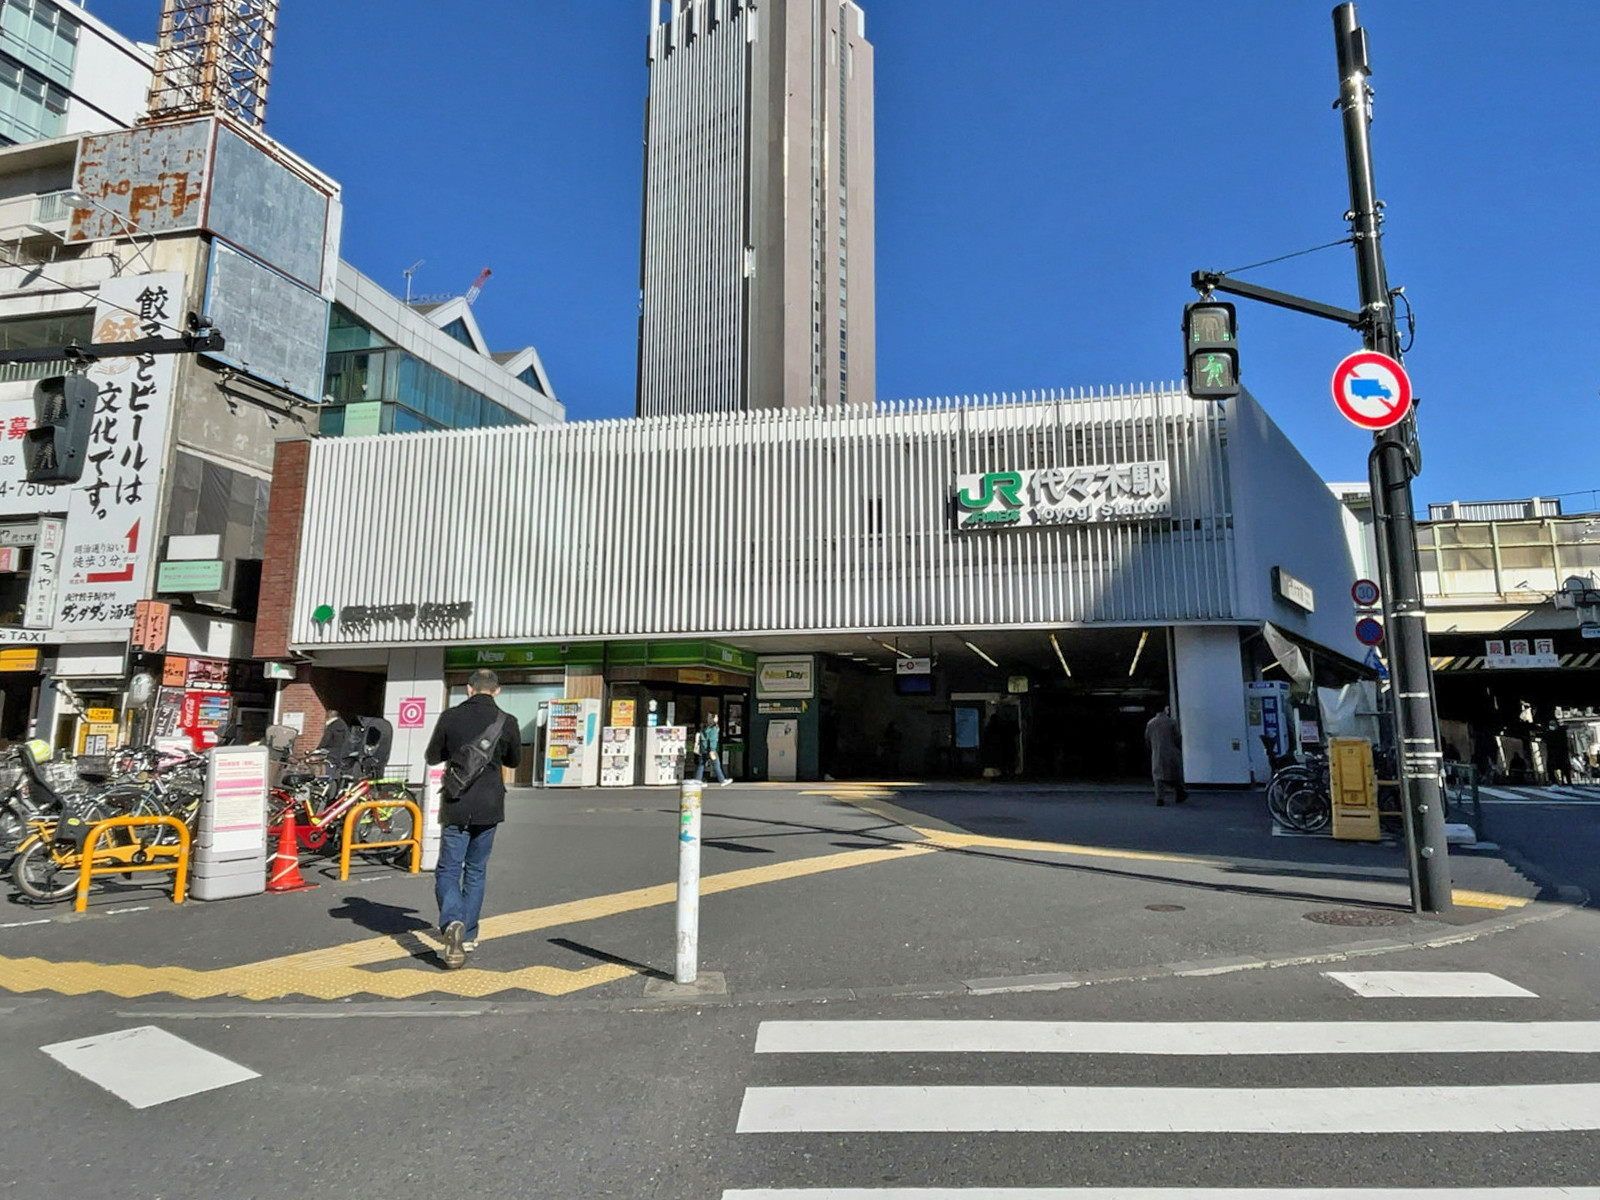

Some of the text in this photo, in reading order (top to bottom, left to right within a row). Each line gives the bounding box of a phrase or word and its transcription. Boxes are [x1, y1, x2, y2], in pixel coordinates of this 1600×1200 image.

[84, 381, 123, 520] 文化です。
[959, 471, 1024, 508] JR
[1031, 464, 1168, 502] 代々木駅
[1033, 498, 1170, 522] Yoyogi Station
[37, 551, 55, 591] つちや
[1357, 585, 1375, 600] 30
[10, 631, 46, 642] TAXI
